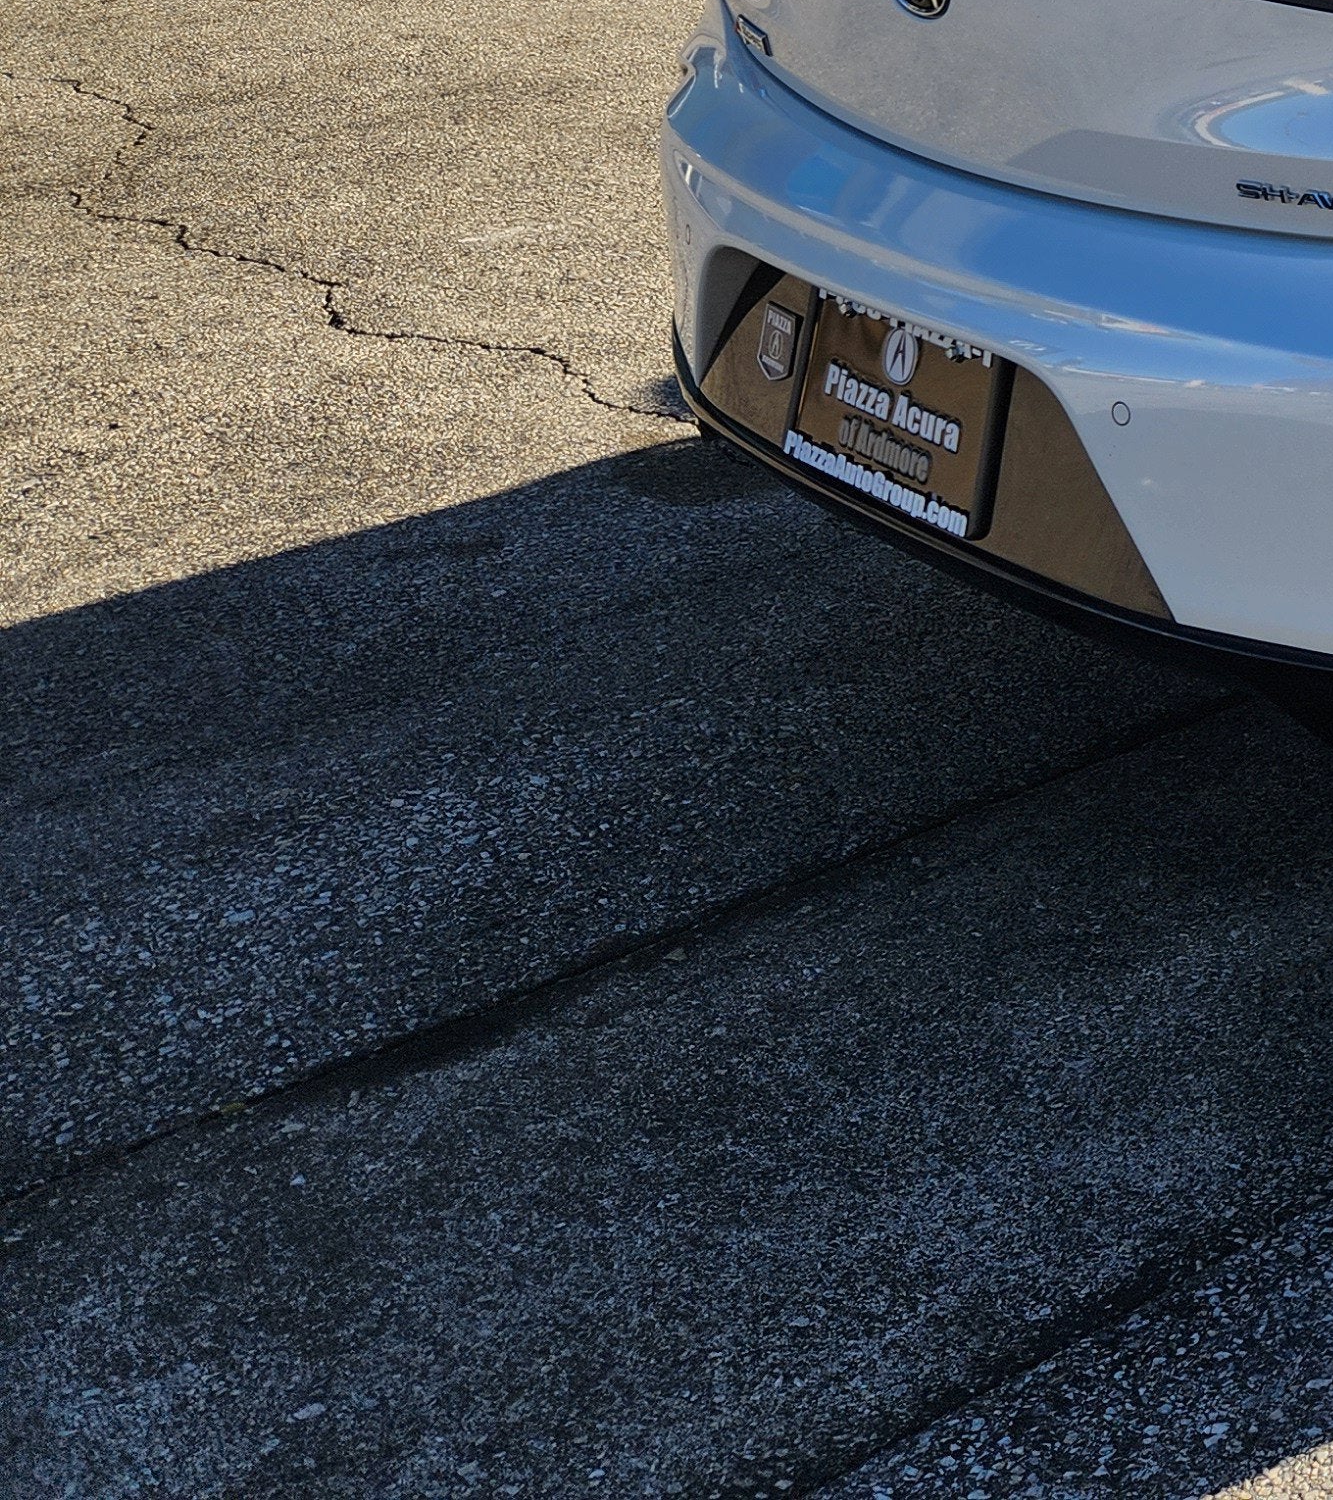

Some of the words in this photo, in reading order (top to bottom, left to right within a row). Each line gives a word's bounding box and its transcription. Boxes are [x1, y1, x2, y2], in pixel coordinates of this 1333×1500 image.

[824, 363, 889, 421] Piazza
[892, 395, 961, 453] Acura
[838, 416, 860, 449] of
[854, 422, 931, 482] Ardmore
